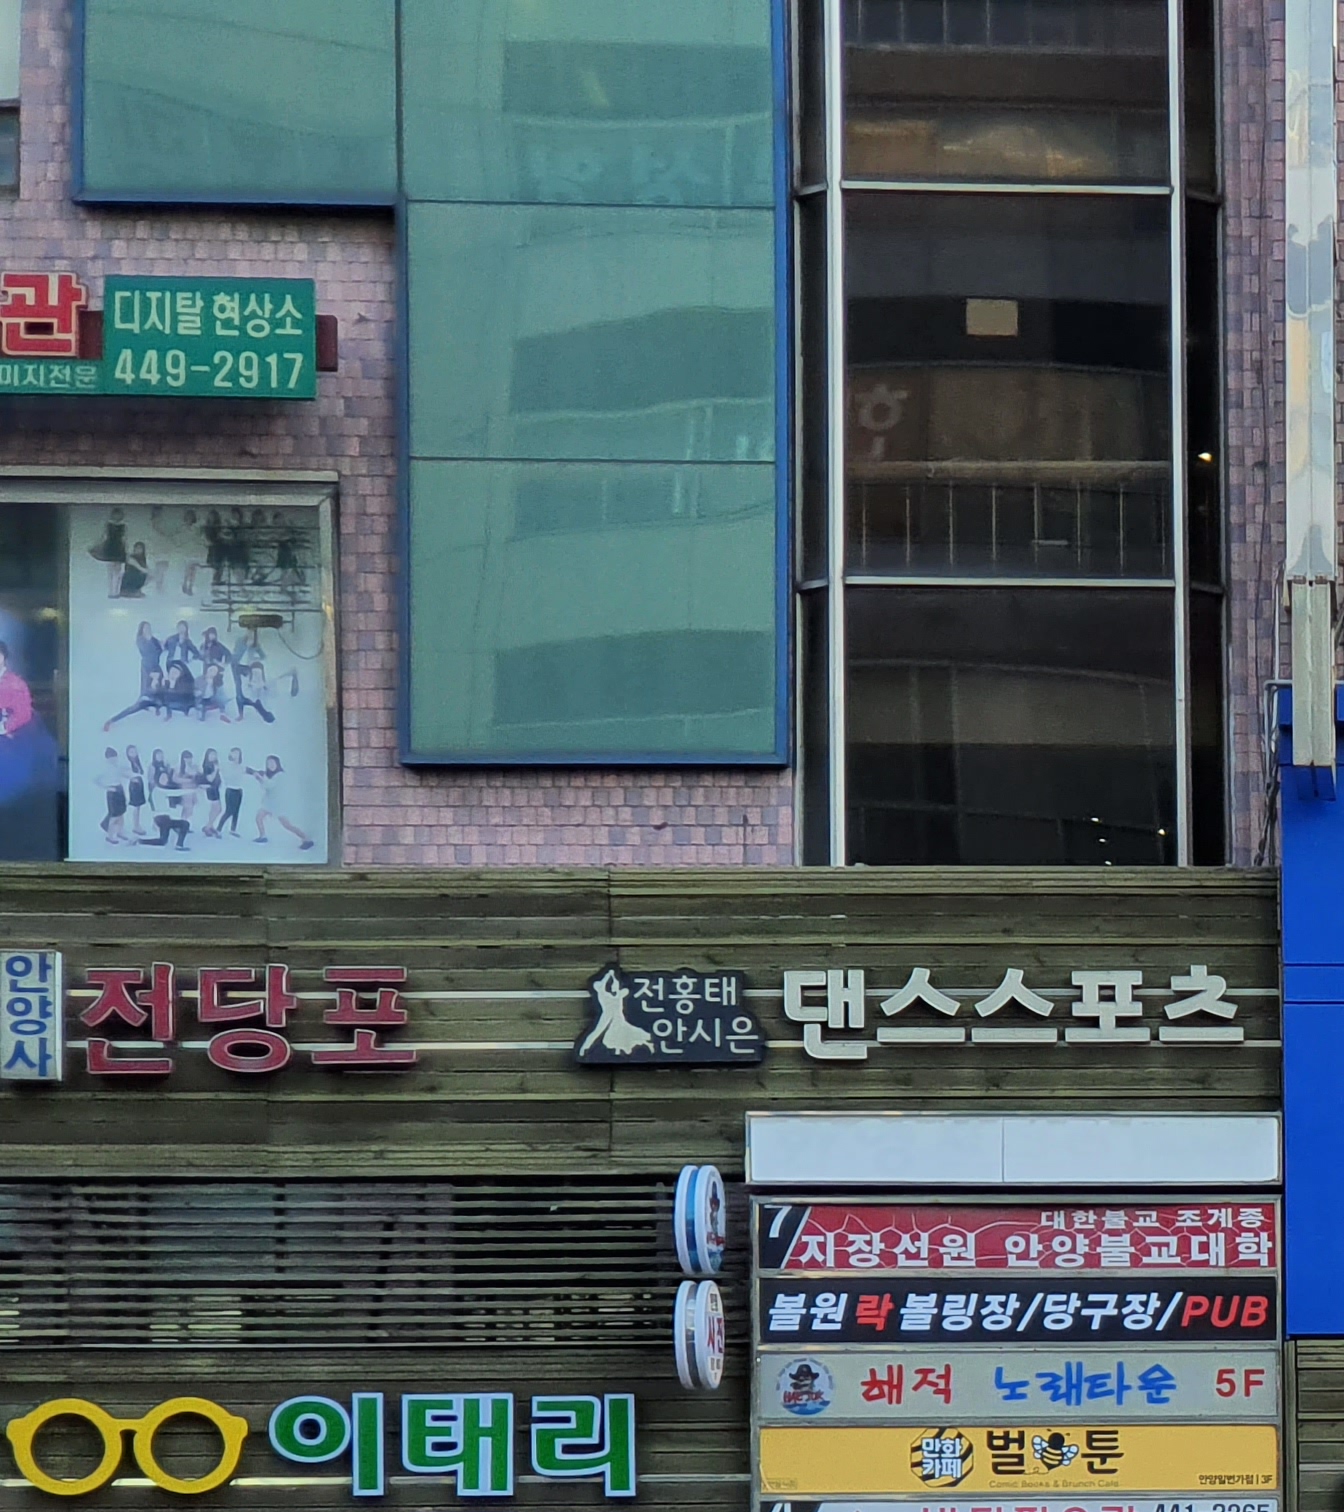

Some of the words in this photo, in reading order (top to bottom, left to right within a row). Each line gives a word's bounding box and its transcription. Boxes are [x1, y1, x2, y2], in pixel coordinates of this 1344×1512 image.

[113, 290, 204, 337] 디지탈
[212, 292, 304, 338] 현상소
[113, 351, 304, 391] 449-2917
[4, 952, 53, 1078] 안양사
[633, 978, 738, 1014] 전홍태
[783, 964, 1246, 1061] 댄스스포츠
[80, 961, 418, 1076] 전당포
[652, 1015, 761, 1055] 안시은
[764, 1205, 793, 1239] 7
[1040, 1207, 1161, 1229] 대한불교
[1176, 1208, 1265, 1229] 조계종
[800, 1232, 977, 1268] 지장선원
[1004, 1230, 1274, 1268] 안양불교대학
[860, 1364, 953, 1405] 해적
[994, 1361, 1178, 1407] 노래타운
[1215, 1367, 1266, 1398] 5F
[268, 1392, 636, 1497] 이태리
[920, 1430, 962, 1455] 만화
[920, 1454, 962, 1480] 카페
